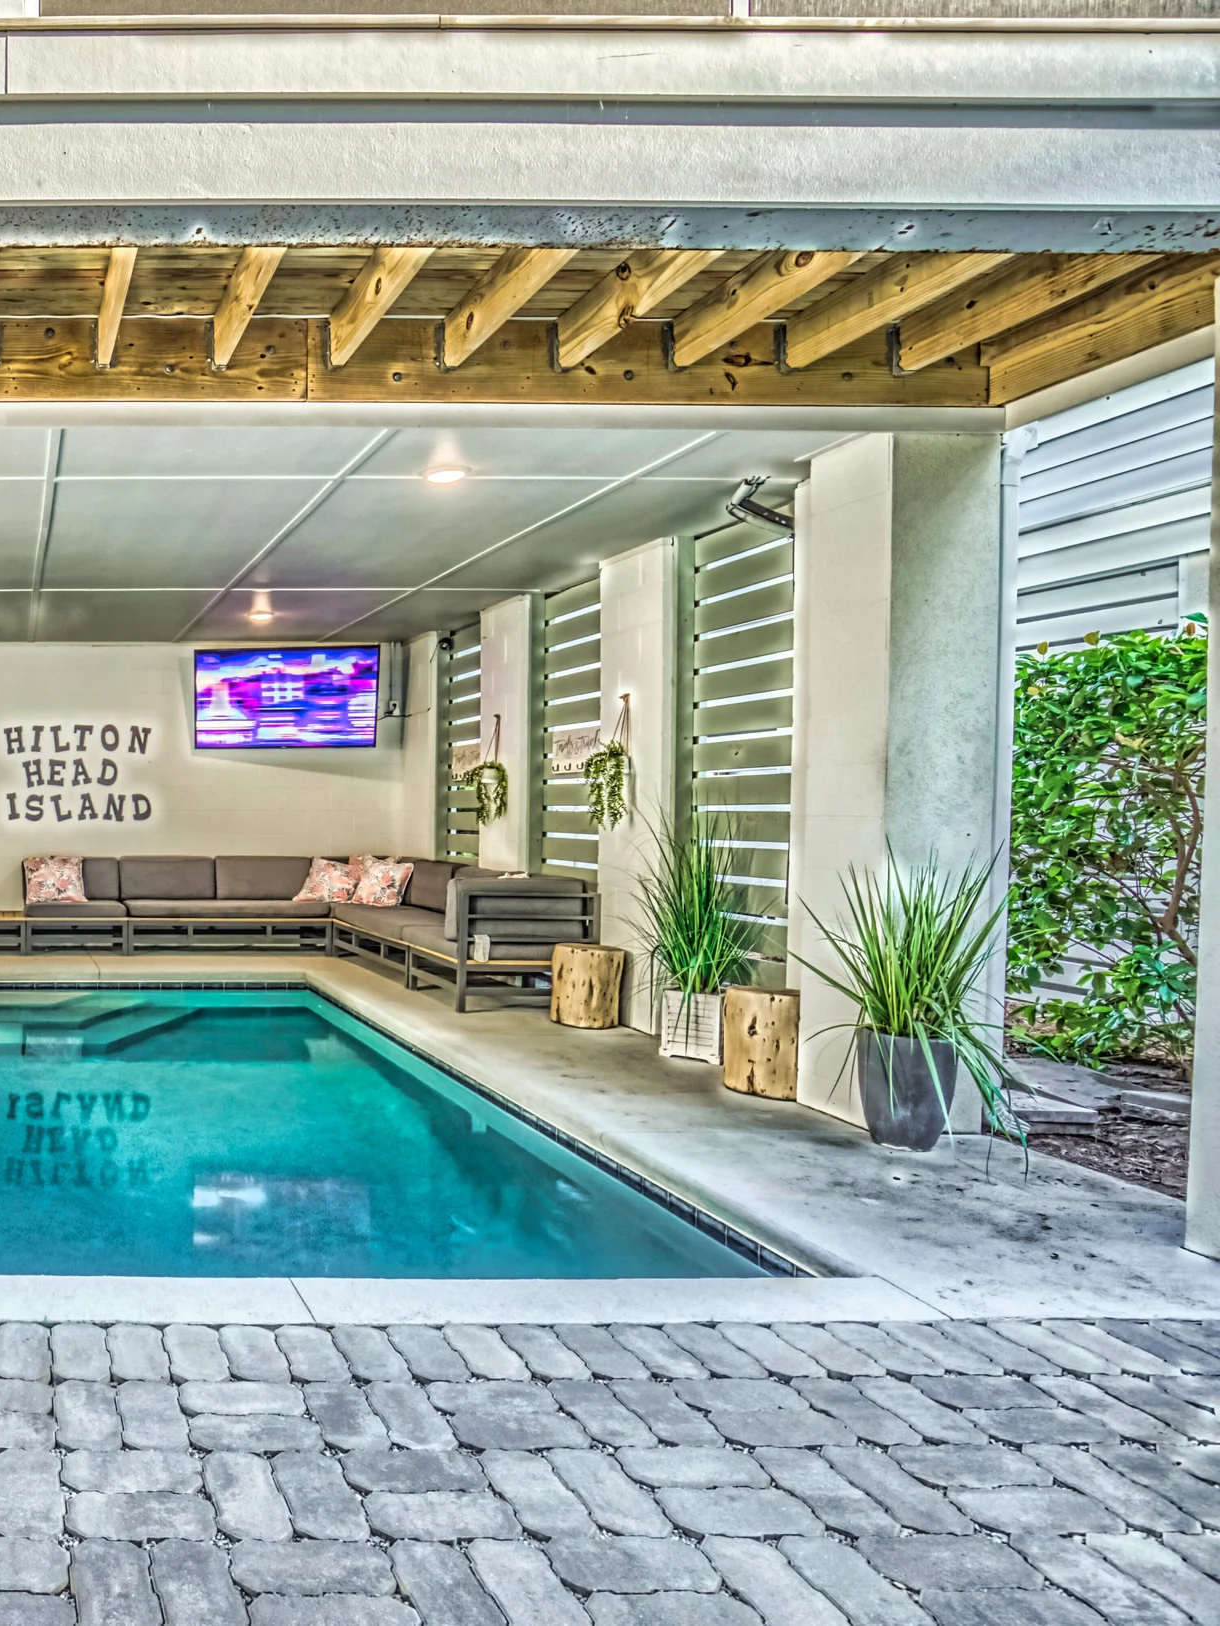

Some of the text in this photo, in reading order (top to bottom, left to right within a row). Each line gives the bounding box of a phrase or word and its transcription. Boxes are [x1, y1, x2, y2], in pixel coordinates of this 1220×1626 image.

[3, 724, 152, 755] HILTON
[22, 757, 118, 788] HEAD
[6, 792, 152, 822] ISLAND
